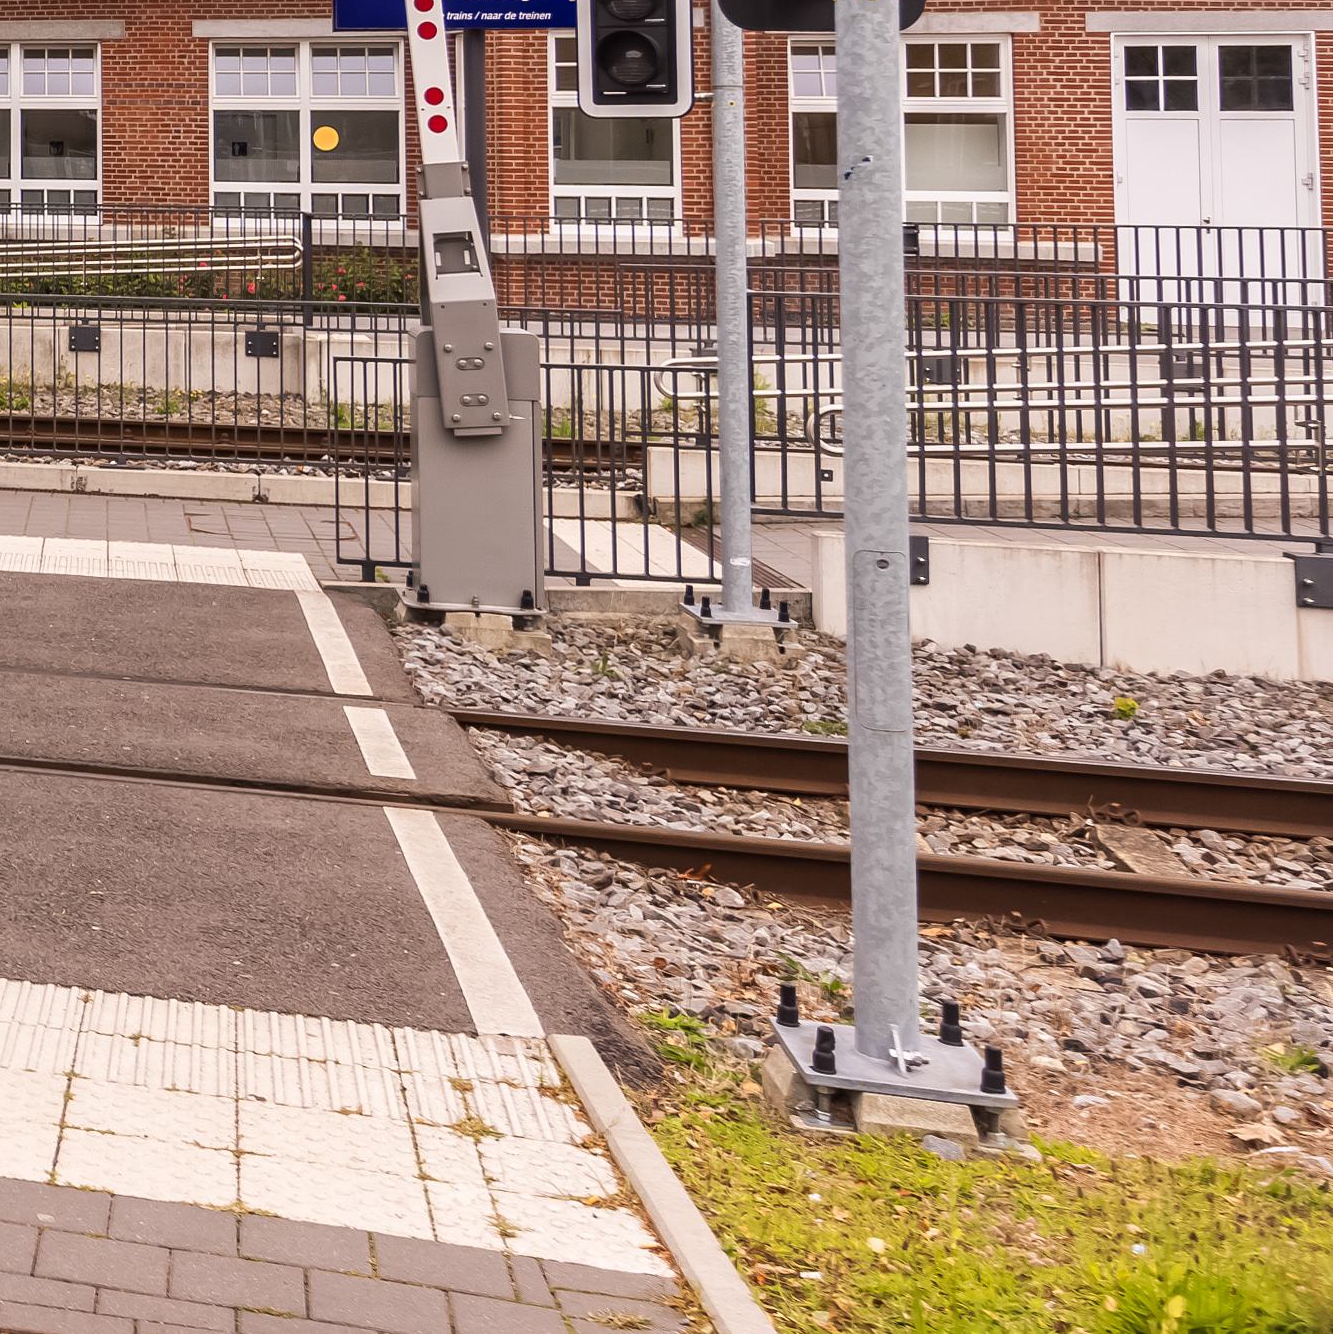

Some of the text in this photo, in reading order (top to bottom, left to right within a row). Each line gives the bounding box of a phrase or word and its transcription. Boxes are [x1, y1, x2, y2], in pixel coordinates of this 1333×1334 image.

[446, 11, 473, 21] trains
[481, 12, 503, 21] naar
[504, 11, 517, 21] de
[518, 12, 552, 21] treinen
